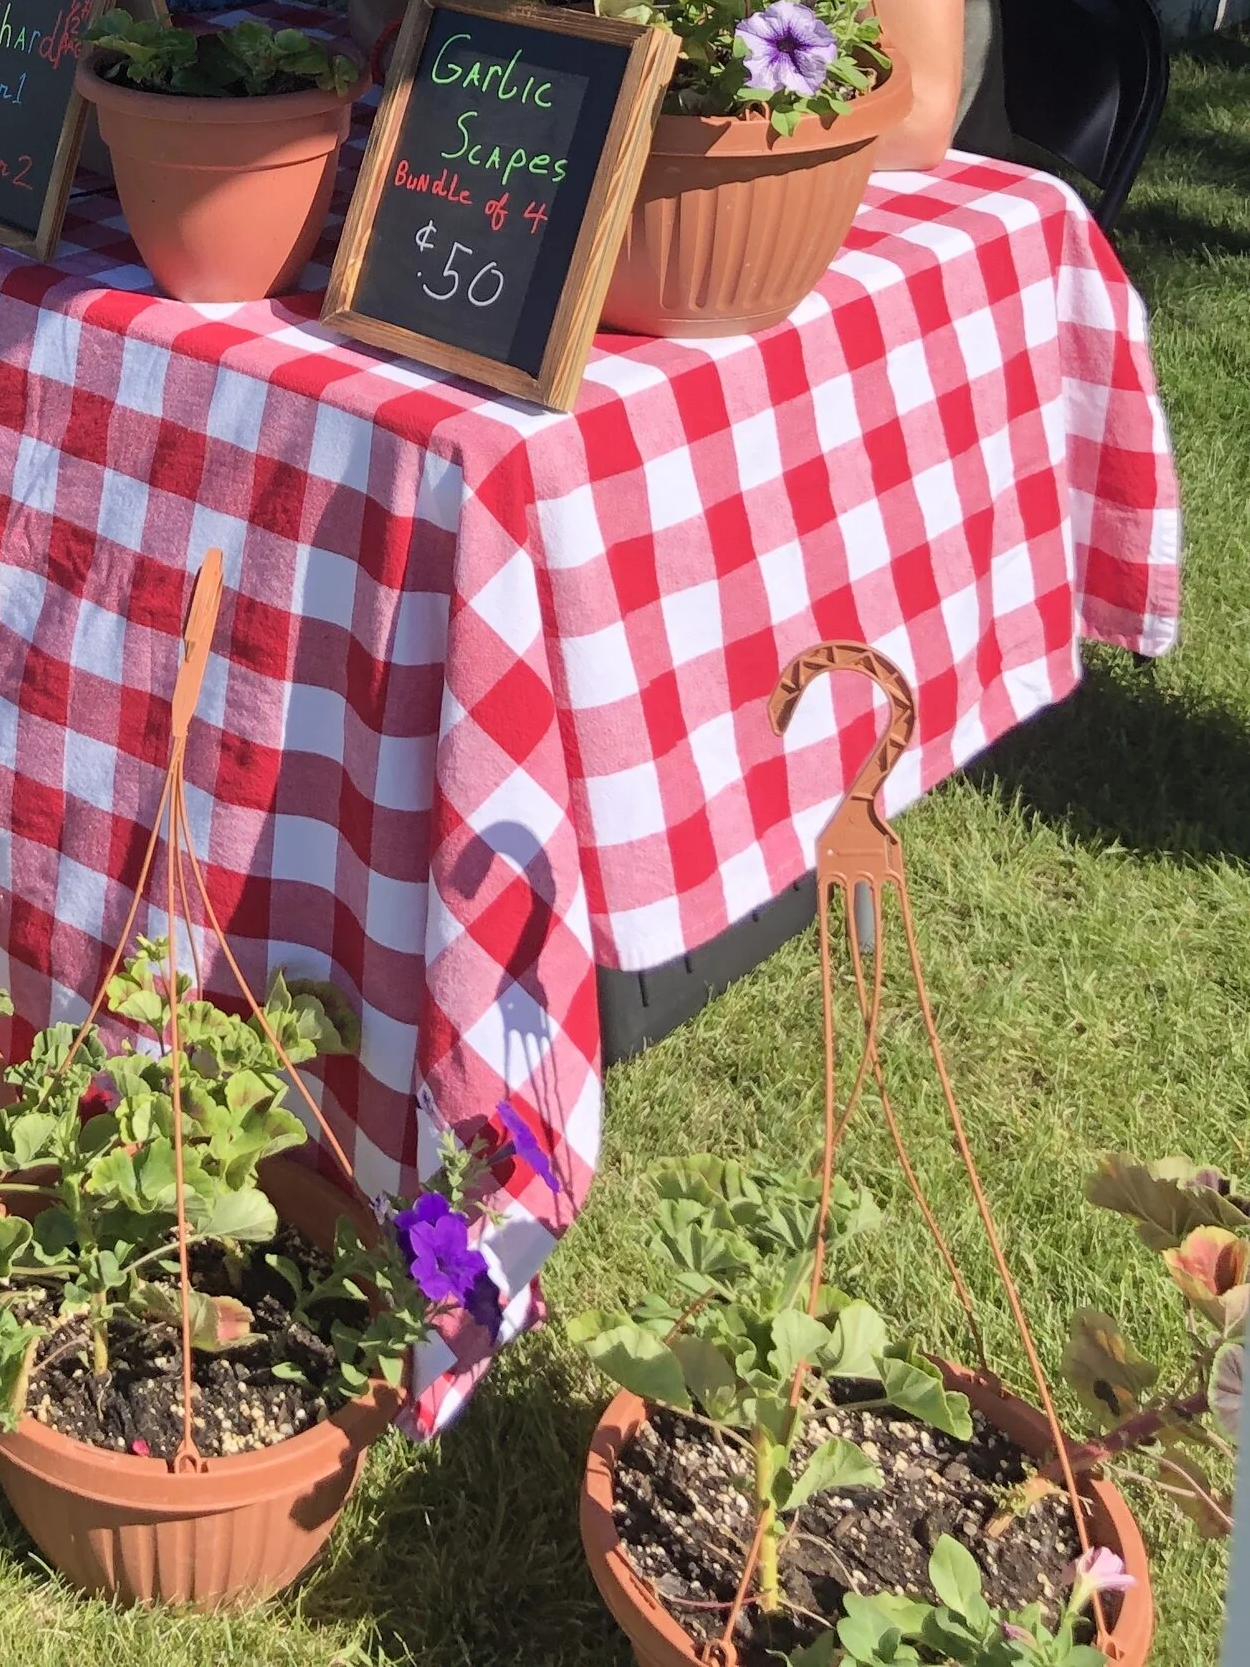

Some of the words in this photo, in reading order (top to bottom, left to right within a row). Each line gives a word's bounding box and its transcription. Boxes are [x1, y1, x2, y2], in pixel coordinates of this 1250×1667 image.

[12, 72, 27, 105] 1
[13, 155, 32, 190] 2
[484, 193, 509, 230] of
[523, 202, 548, 234] 4
